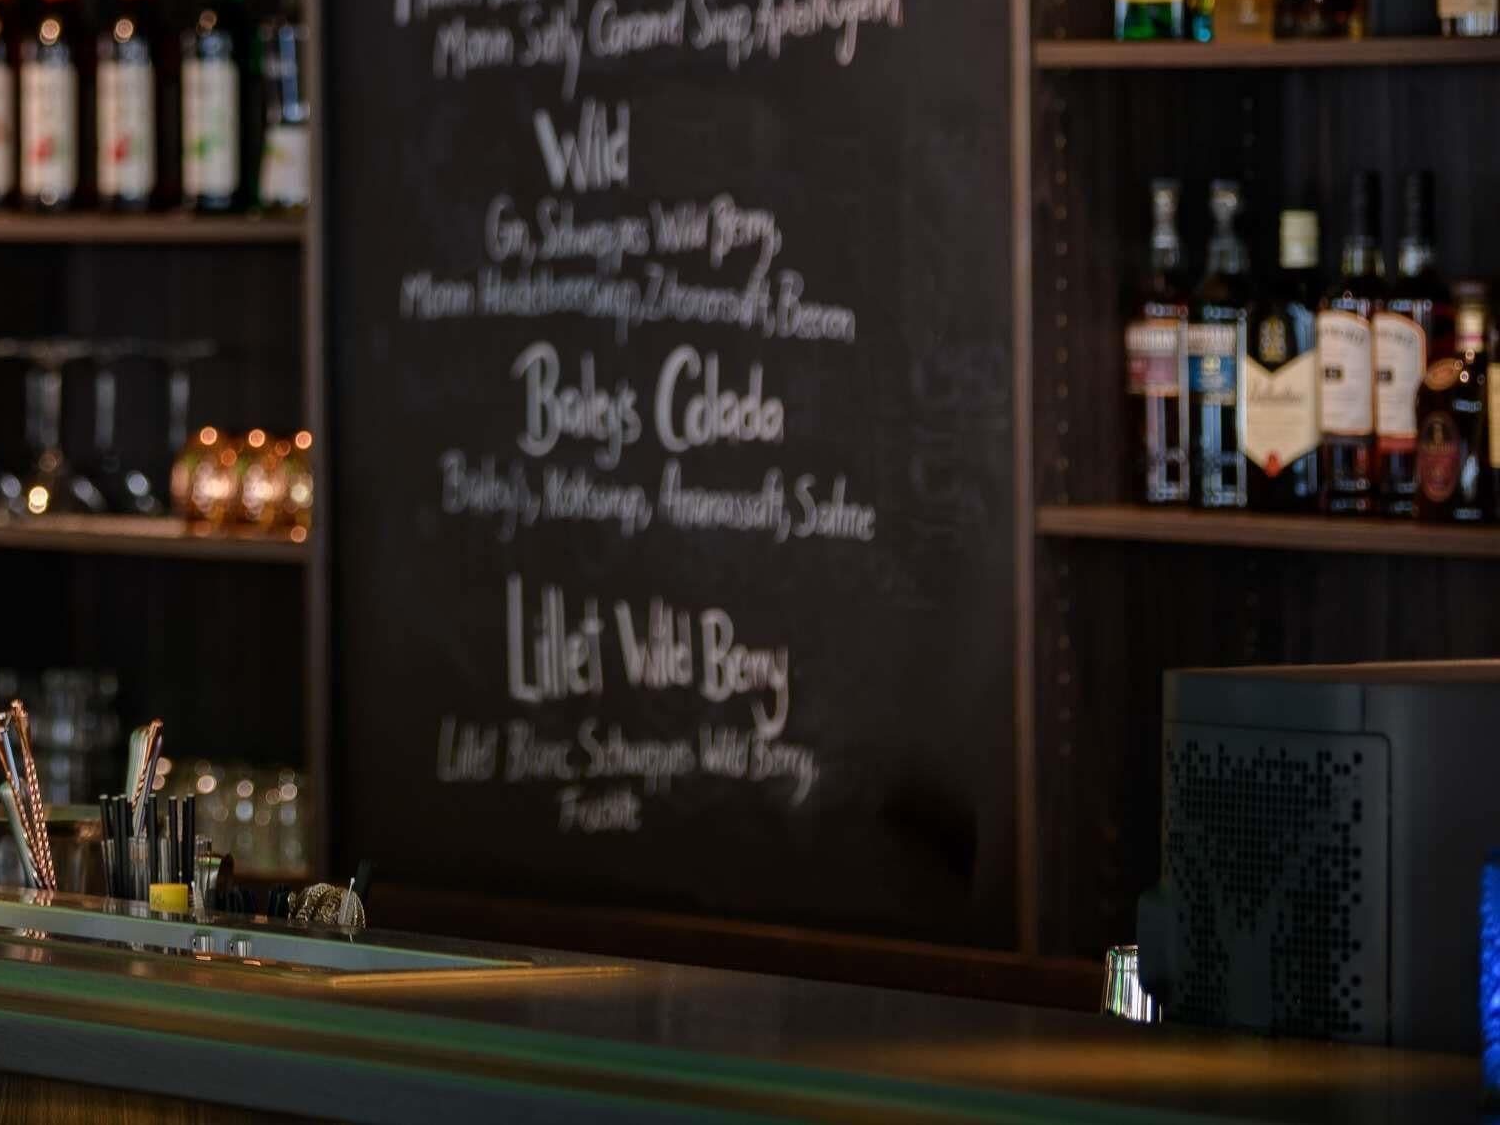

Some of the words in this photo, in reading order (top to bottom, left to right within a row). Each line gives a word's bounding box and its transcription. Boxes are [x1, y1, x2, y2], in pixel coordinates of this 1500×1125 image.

[534, 96, 631, 193] Wild
[655, 343, 785, 454] Colada
[613, 595, 694, 691] Wild
[699, 608, 790, 740] Berry
